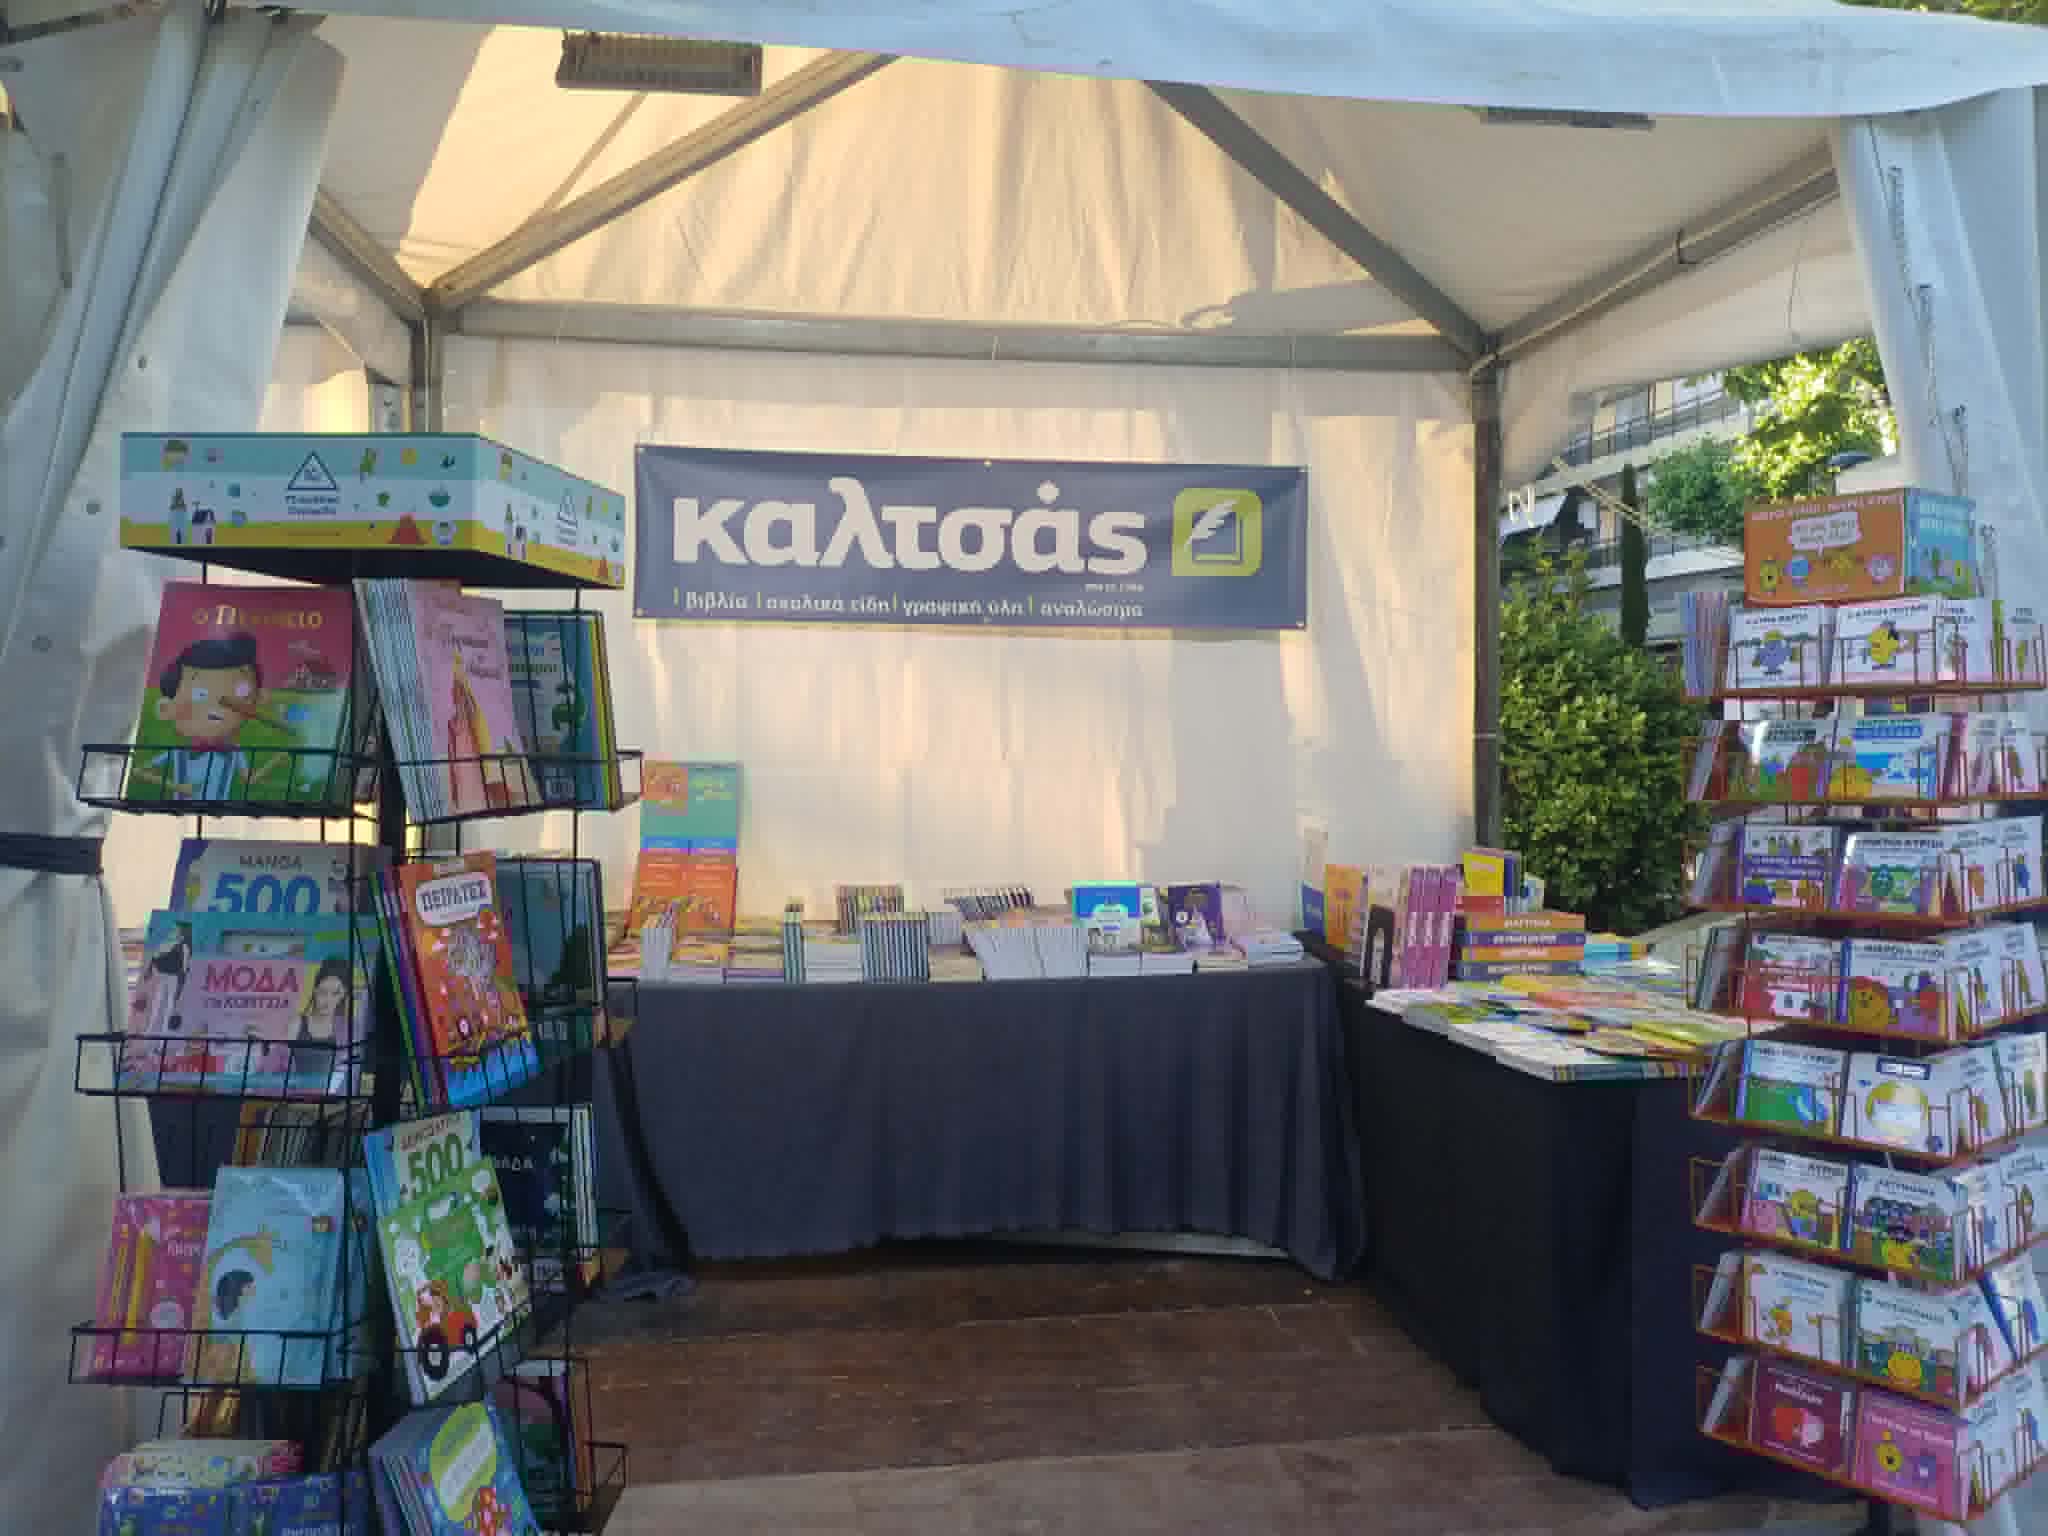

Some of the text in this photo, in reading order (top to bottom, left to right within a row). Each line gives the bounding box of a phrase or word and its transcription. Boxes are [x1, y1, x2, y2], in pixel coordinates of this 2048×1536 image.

[685, 591, 748, 616] βιβλία
[209, 872, 320, 912] 500
[203, 963, 299, 993] ΜΟΔΑ
[408, 1134, 462, 1189] 500
